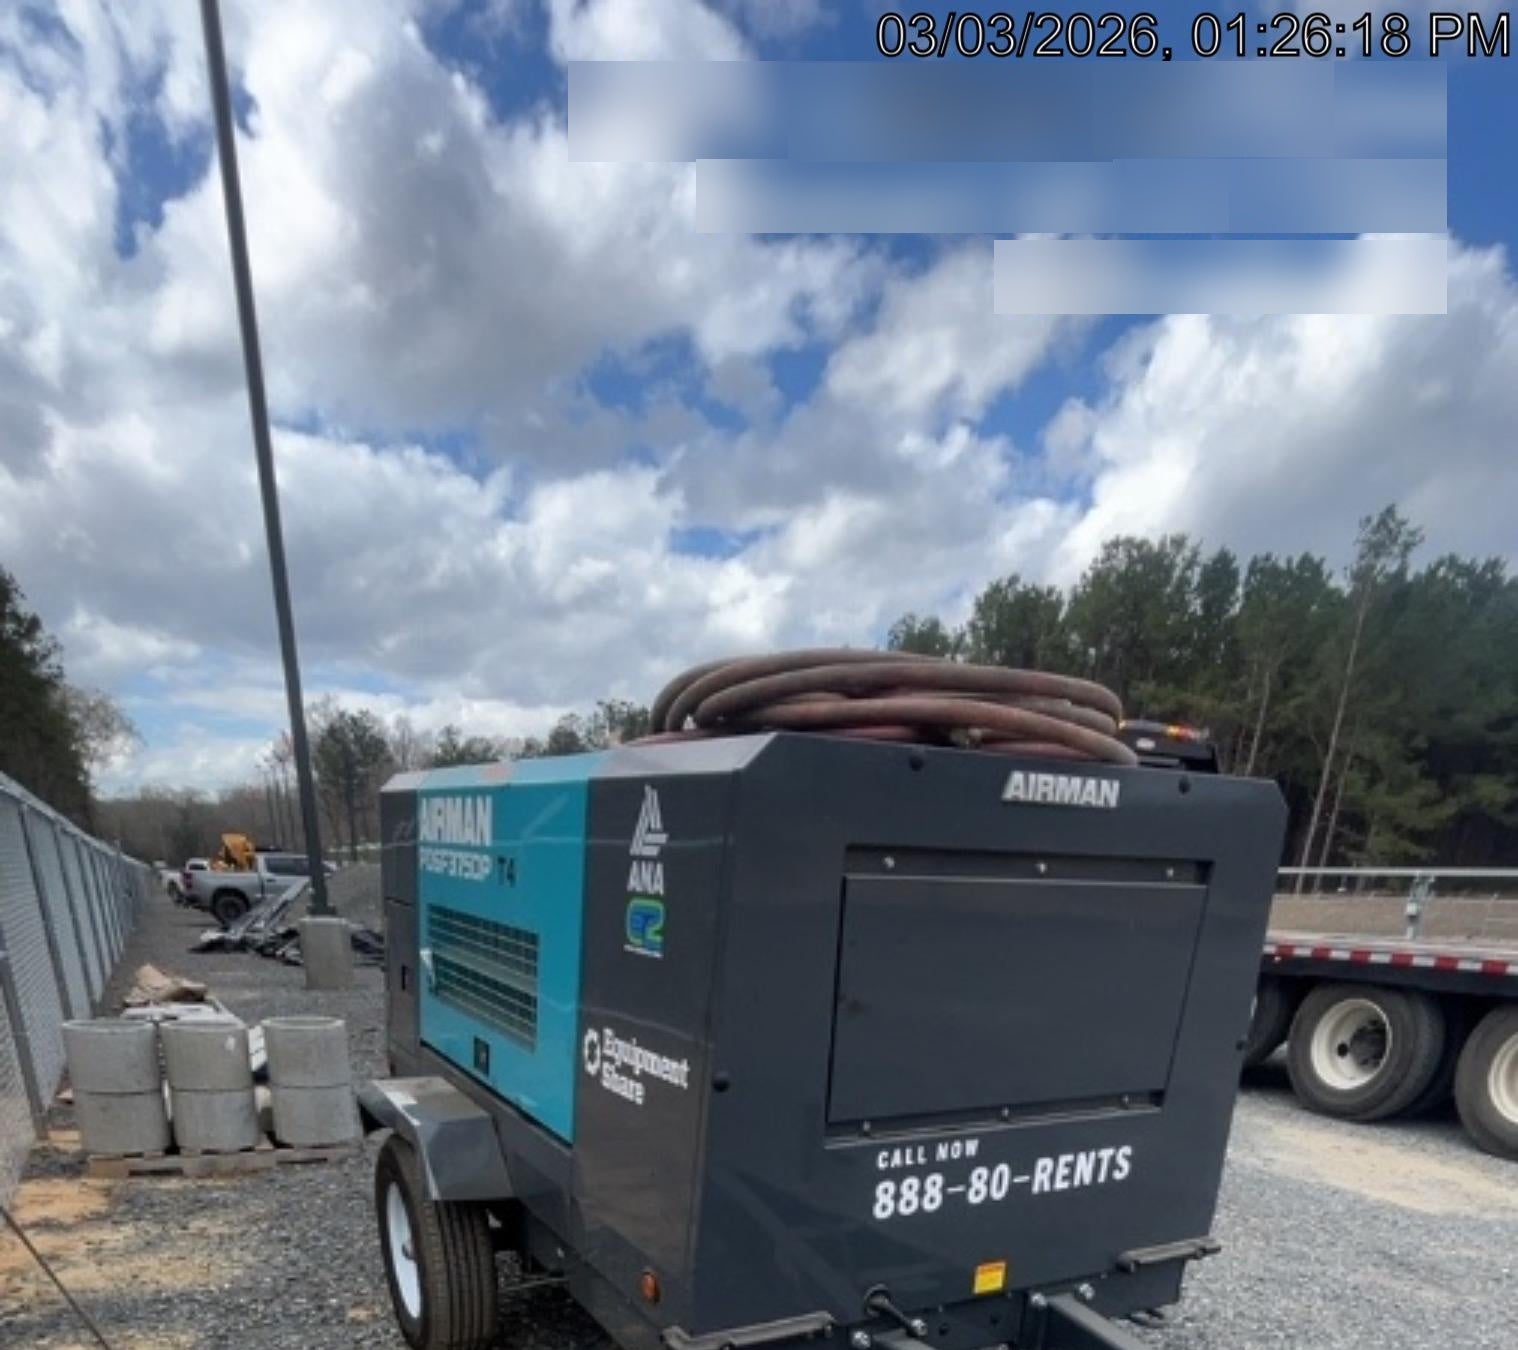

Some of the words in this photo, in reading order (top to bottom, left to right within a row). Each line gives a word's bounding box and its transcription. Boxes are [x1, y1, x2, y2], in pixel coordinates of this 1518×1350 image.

[1002, 770, 1120, 808] AIRMAN
[419, 795, 493, 847] AIRMAN
[626, 860, 664, 896] ANA
[602, 1028, 690, 1090] Equipment
[601, 1061, 645, 1105] Share
[877, 1145, 928, 1169] CALL
[935, 1139, 980, 1162] NOW
[873, 1145, 1132, 1220] 888-80-RENTS
